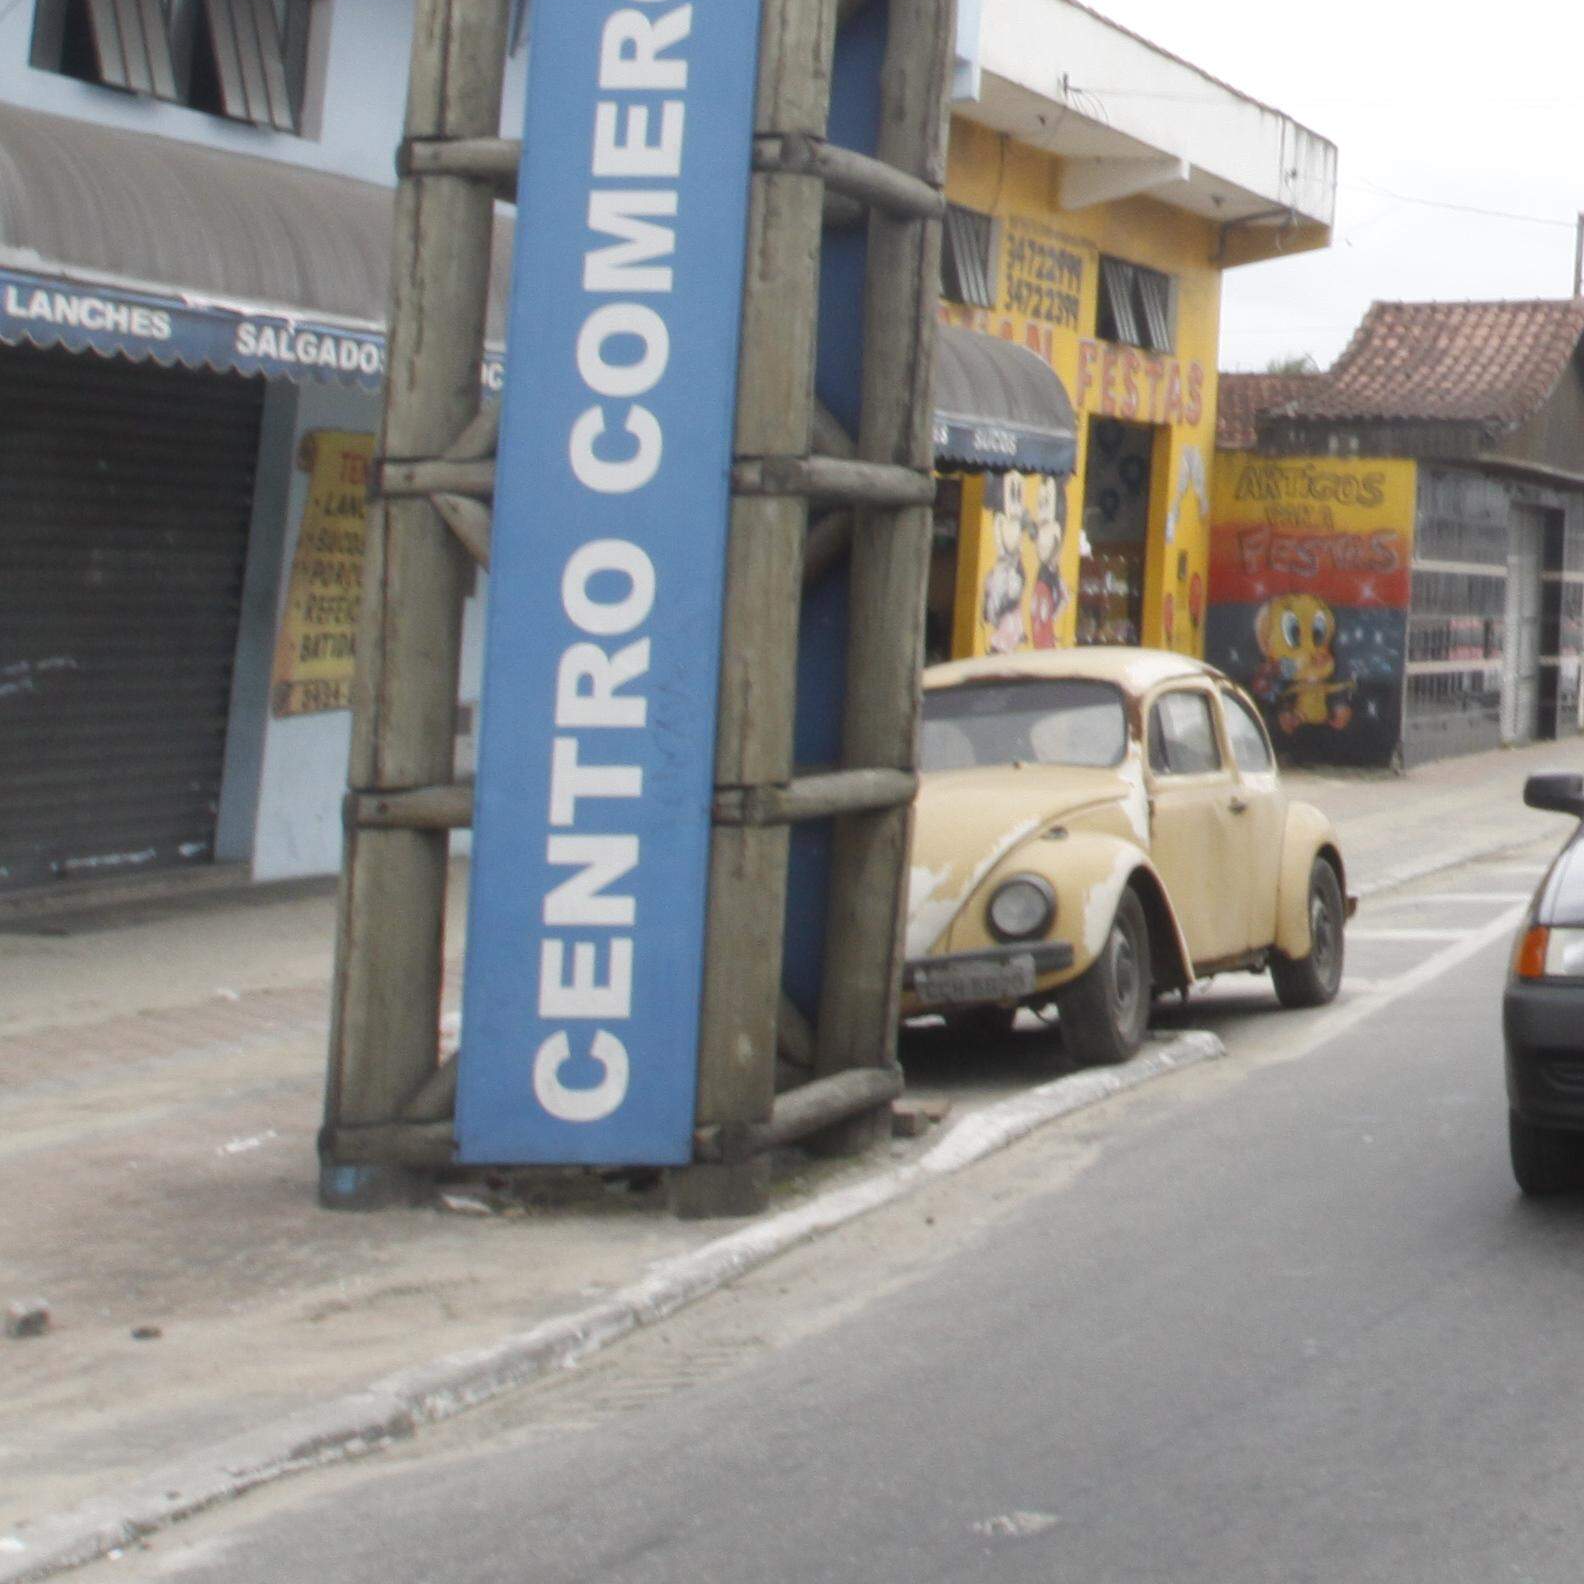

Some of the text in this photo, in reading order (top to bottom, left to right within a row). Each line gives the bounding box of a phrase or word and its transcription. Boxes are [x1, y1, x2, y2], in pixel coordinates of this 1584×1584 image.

[4, 284, 386, 375] LANCHES SALGADO
[1077, 338, 1205, 426] FESTAS
[533, 538, 656, 1122] CENTRO
